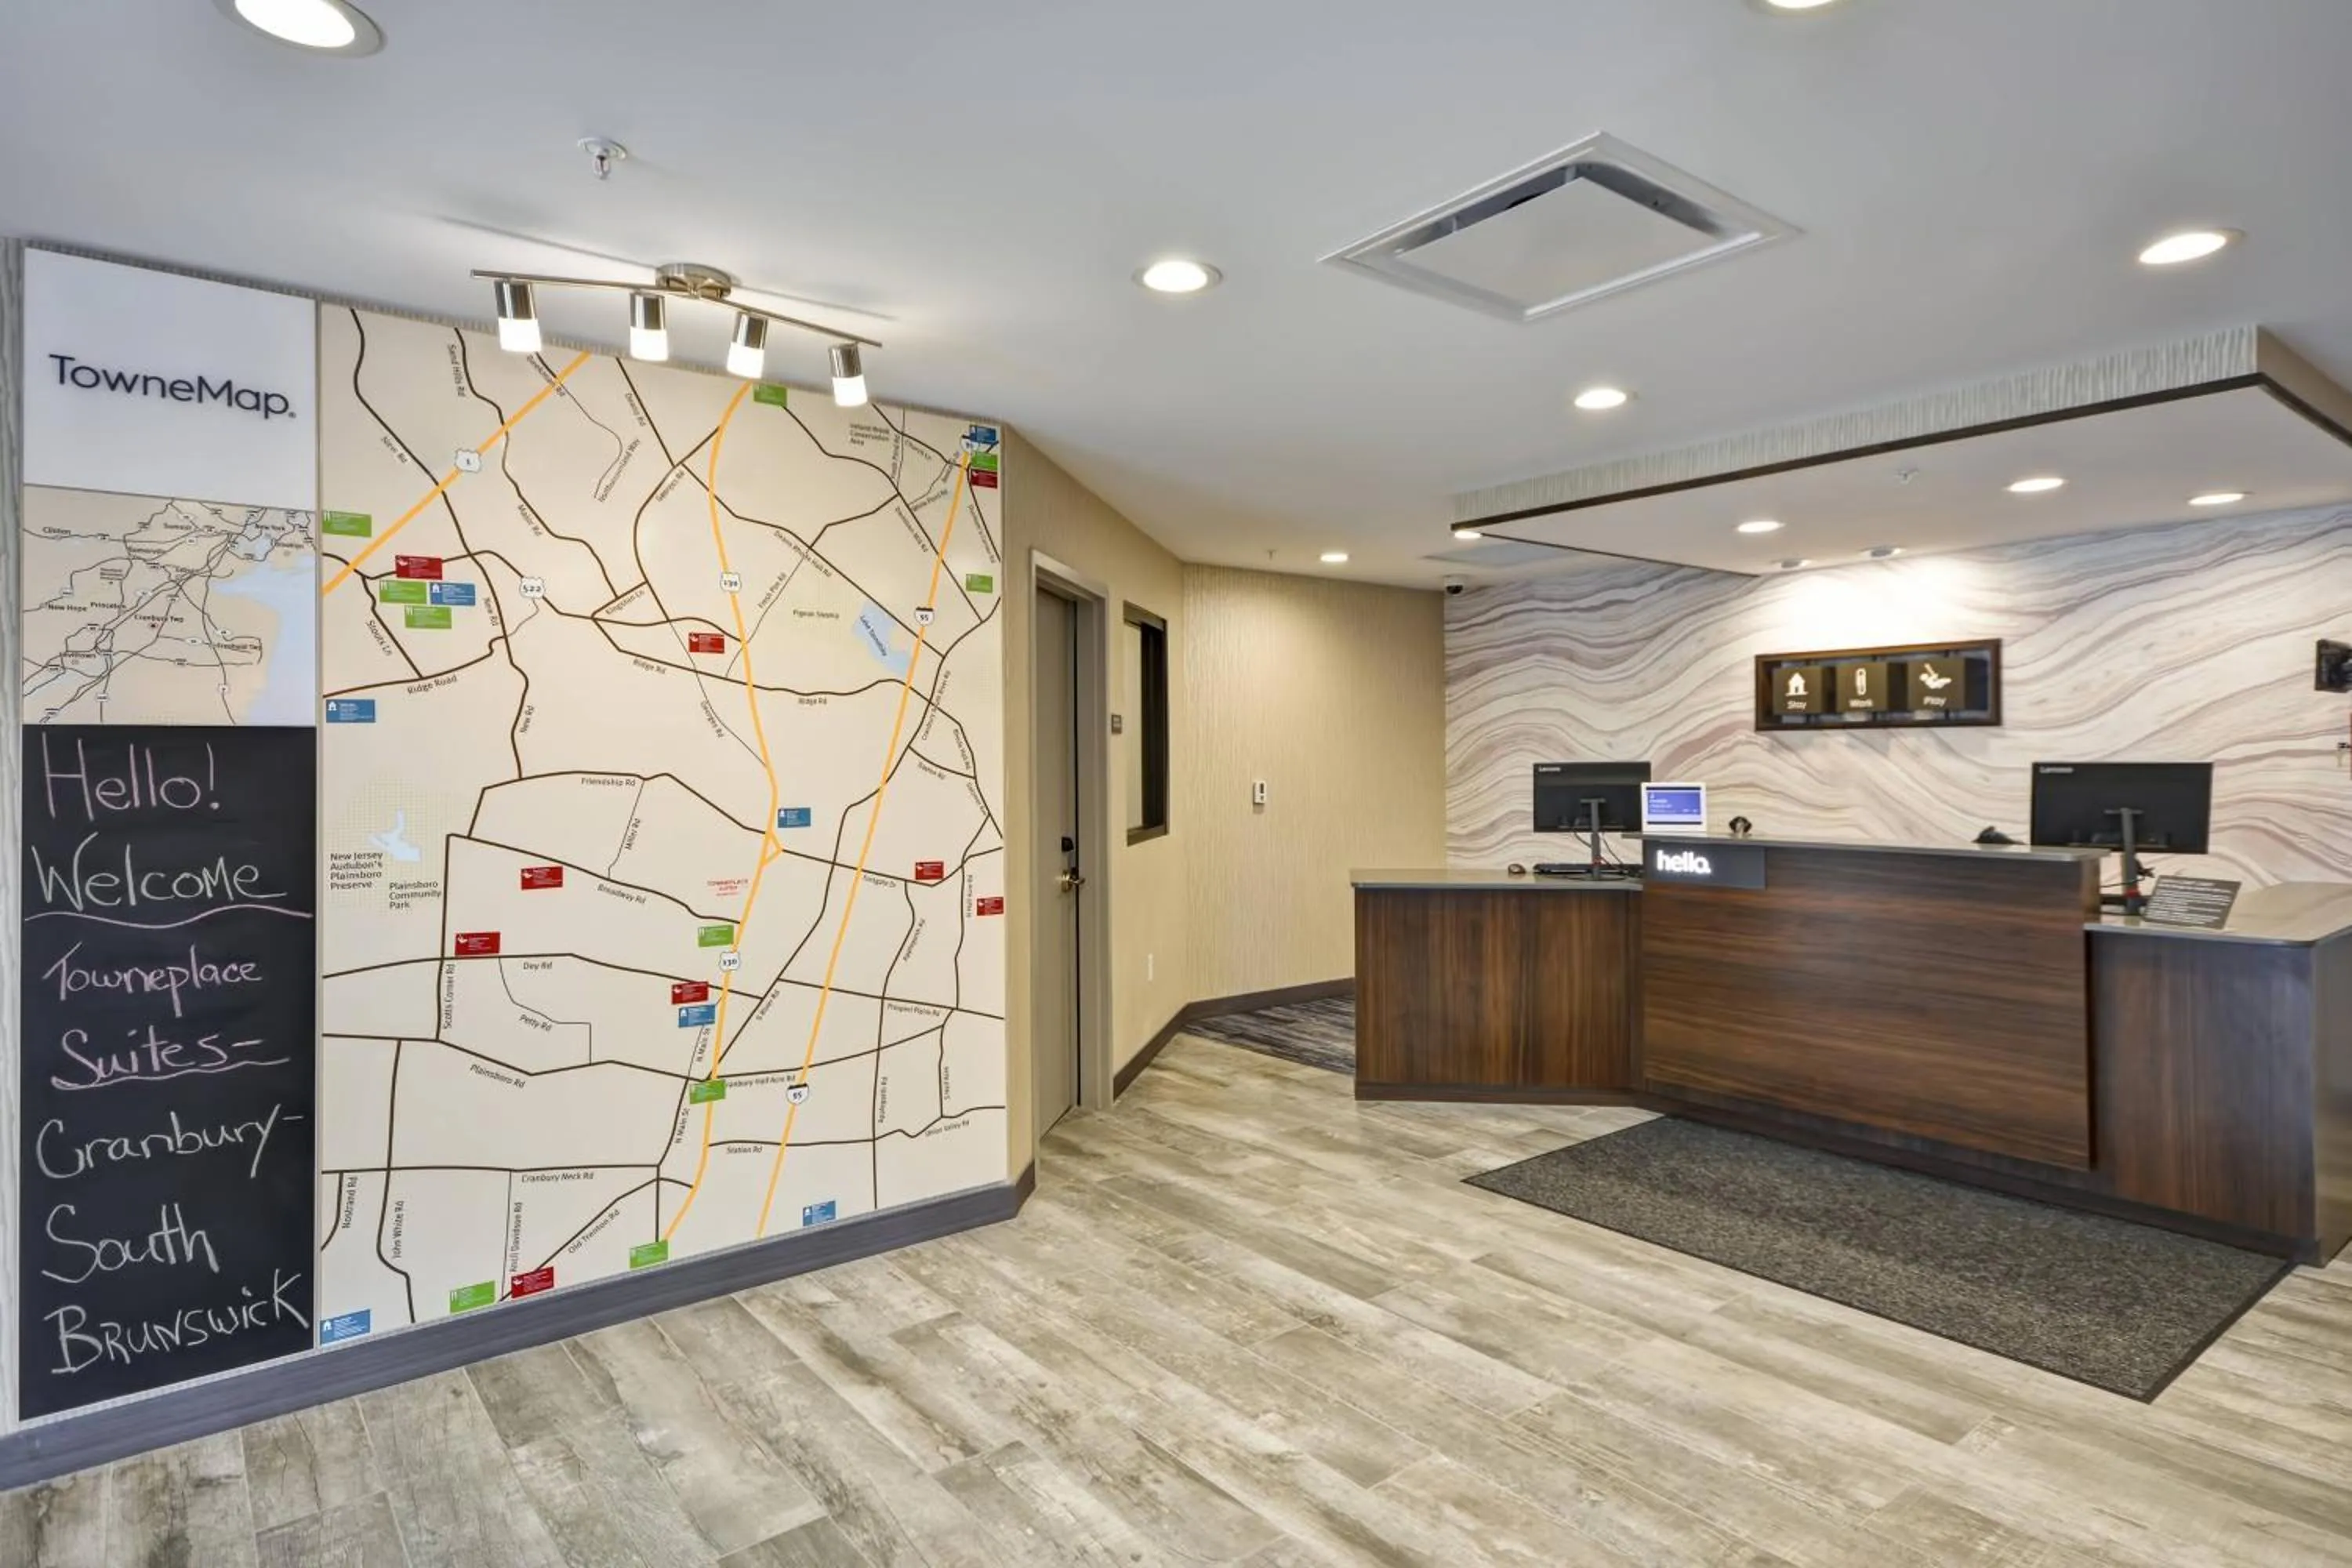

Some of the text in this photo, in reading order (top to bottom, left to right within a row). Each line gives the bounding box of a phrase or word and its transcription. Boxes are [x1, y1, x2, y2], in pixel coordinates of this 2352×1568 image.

[407, 676, 457, 695] Ridge Road
[42, 731, 220, 821] Hello!
[582, 777, 623, 786] Friendship
[354, 852, 383, 862] Jersey
[330, 871, 382, 880] Plainsboro
[330, 880, 372, 890] Preserve
[389, 881, 438, 890] Plainsboro
[389, 891, 441, 899] Community
[389, 901, 410, 909] Park
[523, 961, 553, 971] Dey Rd
[42, 942, 263, 1018] Towneplace
[520, 1014, 553, 1032] Petty Rd
[514, 1077, 525, 1088] Rd
[521, 1174, 559, 1183] Cranbury
[561, 1172, 582, 1181] Neck
[568, 1240, 584, 1254] Old
[580, 1218, 609, 1245] Trenton
[42, 1203, 220, 1283] South
